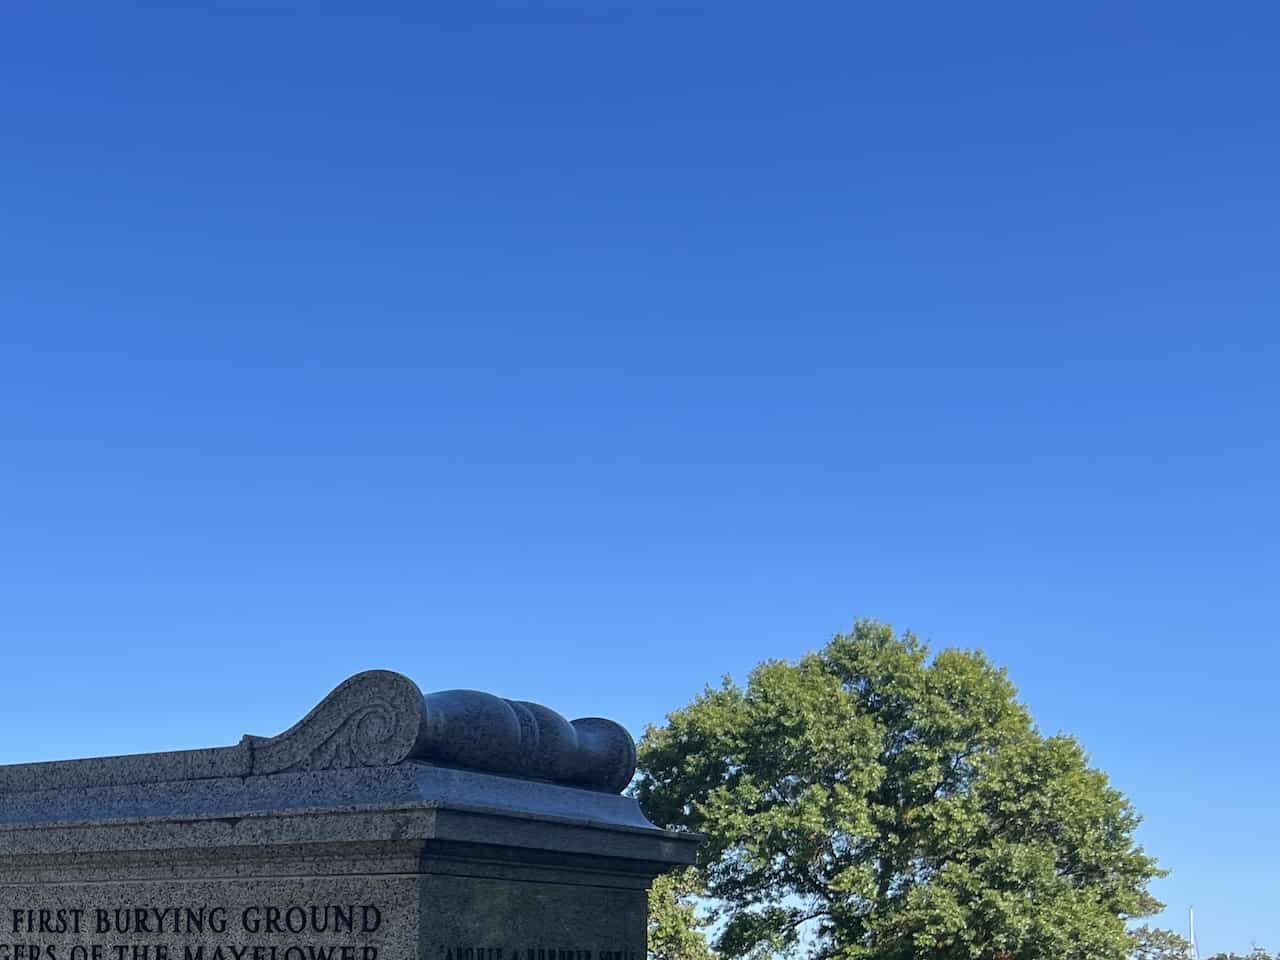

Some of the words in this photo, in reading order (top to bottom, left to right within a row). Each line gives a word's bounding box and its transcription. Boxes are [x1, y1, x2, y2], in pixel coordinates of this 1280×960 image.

[11, 907, 85, 934] FIRST
[95, 905, 227, 934] BURYING
[240, 904, 382, 933] GROUND
